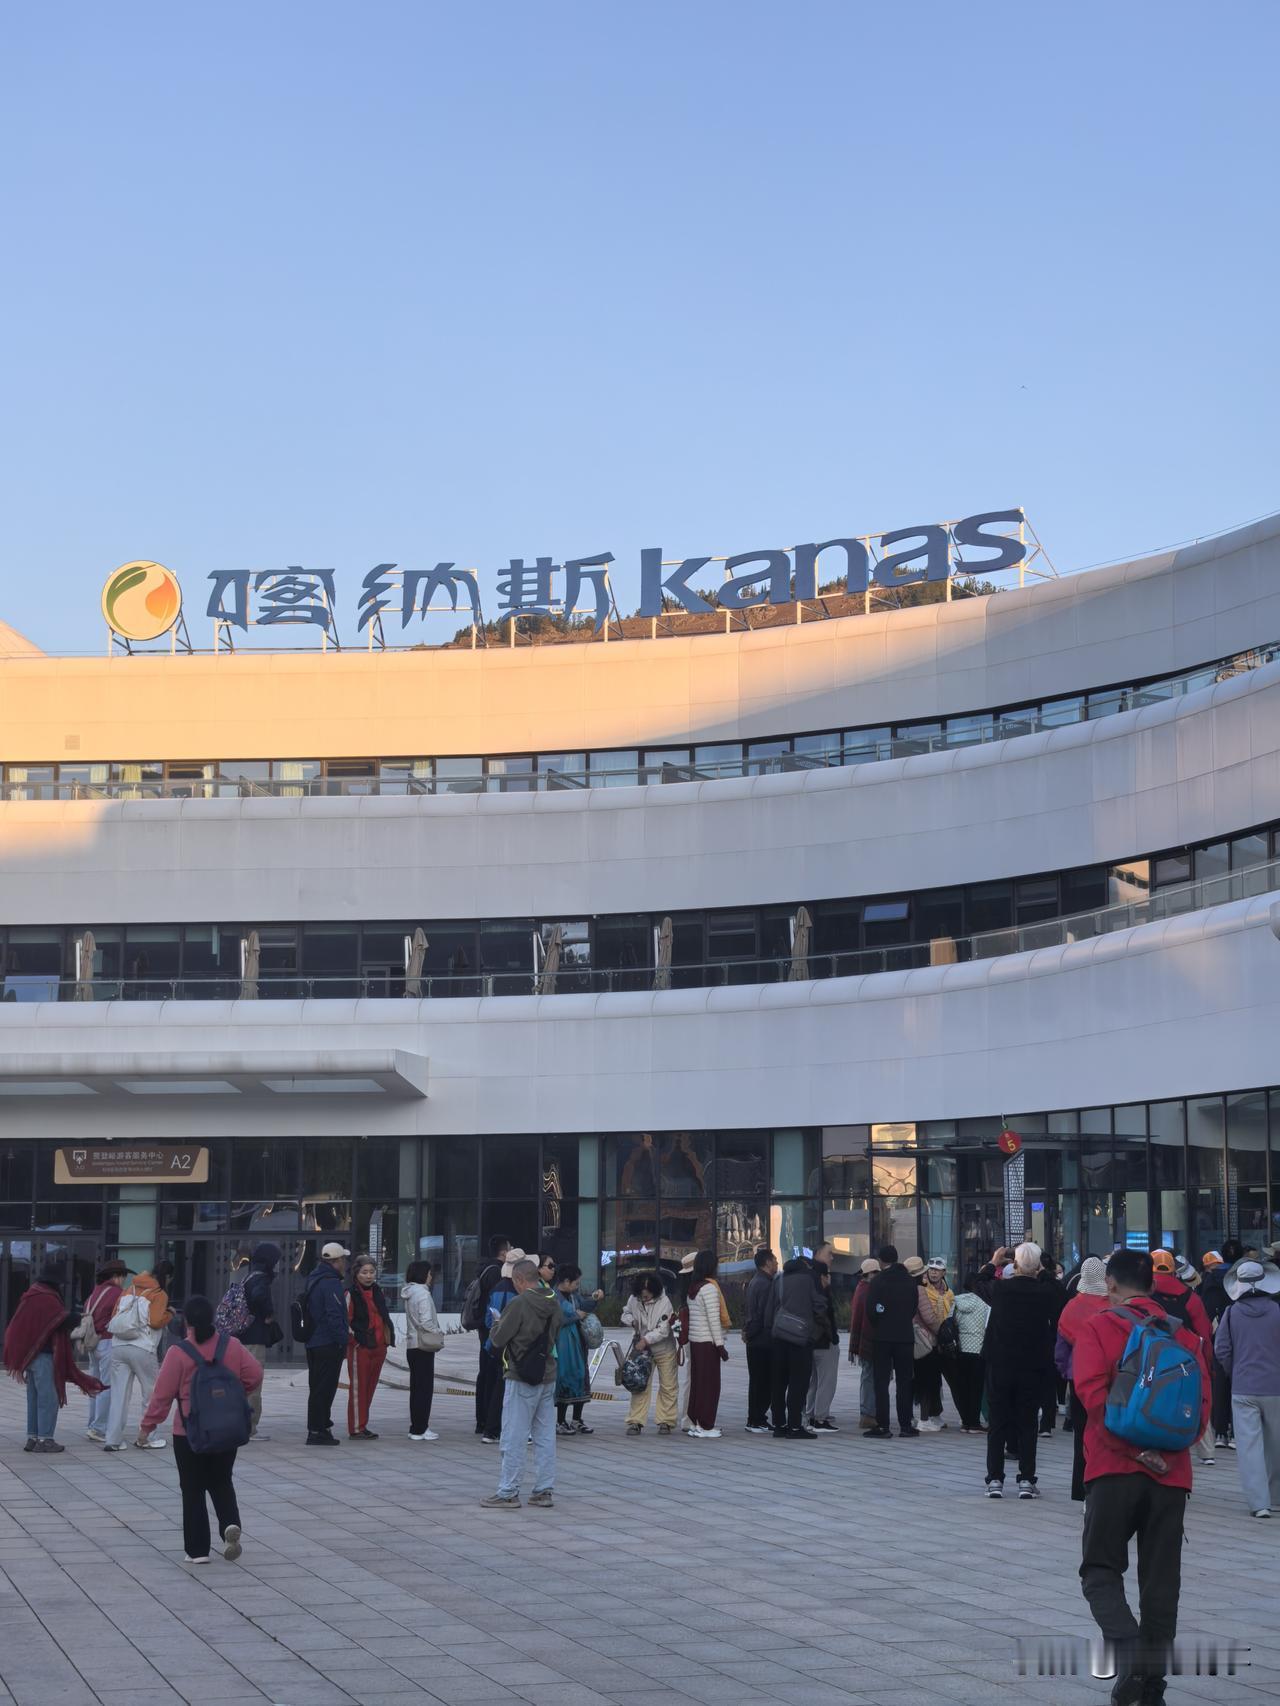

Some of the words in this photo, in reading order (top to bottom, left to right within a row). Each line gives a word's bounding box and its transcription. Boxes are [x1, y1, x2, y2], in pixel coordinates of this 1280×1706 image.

[640, 508, 1027, 618] kanas
[206, 551, 616, 635] 喀纳斯
[171, 1155, 191, 1169] A2
[1007, 1139, 1016, 1151] 5
